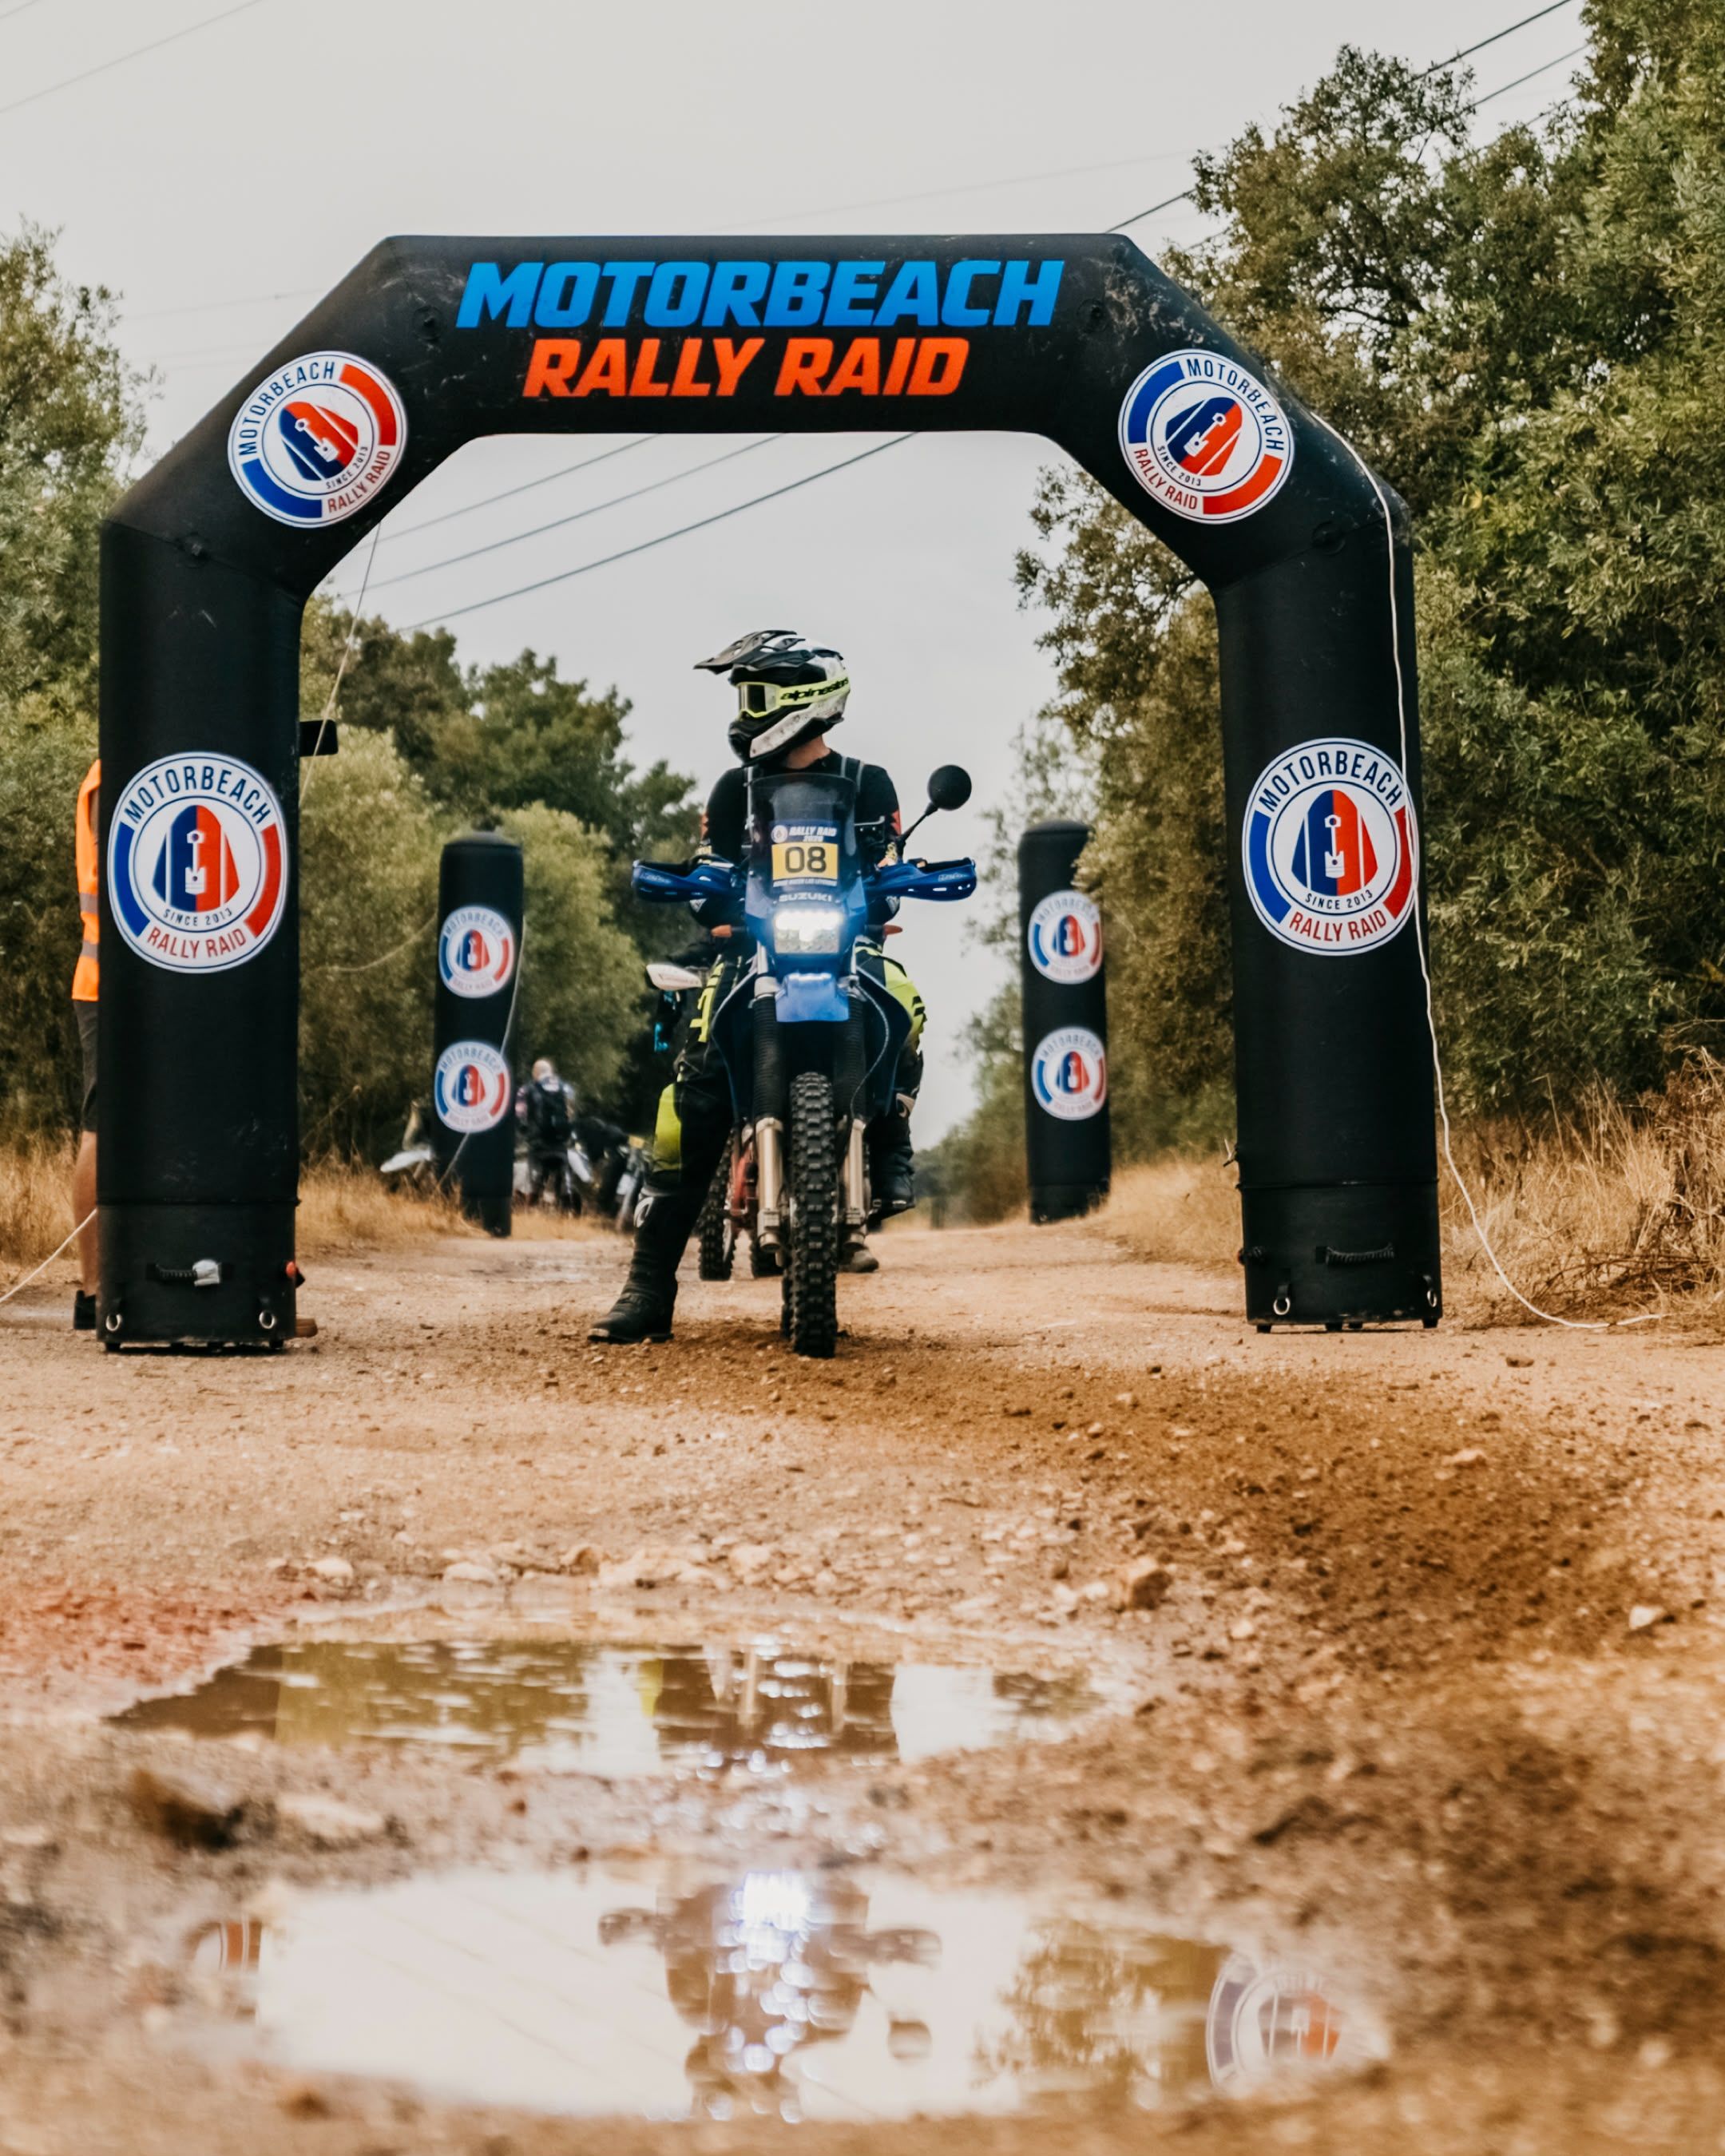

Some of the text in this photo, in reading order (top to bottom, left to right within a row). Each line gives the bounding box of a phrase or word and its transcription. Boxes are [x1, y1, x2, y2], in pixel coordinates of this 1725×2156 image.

[456, 260, 1065, 328] MOTORBEACH
[522, 336, 970, 397] RALLY RAID
[239, 361, 335, 456] MOTORBEACH
[1187, 359, 1285, 451] MOTORBEACH
[326, 446, 369, 489] SINCE 2013
[327, 450, 391, 513] RALLY RAID
[1133, 449, 1198, 510] RALLY RAID
[1157, 445, 1202, 486] SINCE 2013
[124, 765, 272, 825] MOTORBEACH
[1258, 751, 1402, 812] MOTORBEACH
[789, 826, 816, 835] RALLY
[785, 846, 827, 874] 08
[163, 907, 233, 926] SINCE 2013
[779, 891, 832, 902] SUZUKI
[1305, 889, 1374, 910] SINCE 2013
[147, 926, 247, 958] RALLY RAID
[445, 912, 506, 935] MOTORBEACH
[1289, 909, 1387, 941] RALLY RAID
[440, 1047, 502, 1070] MOTORBEACH
